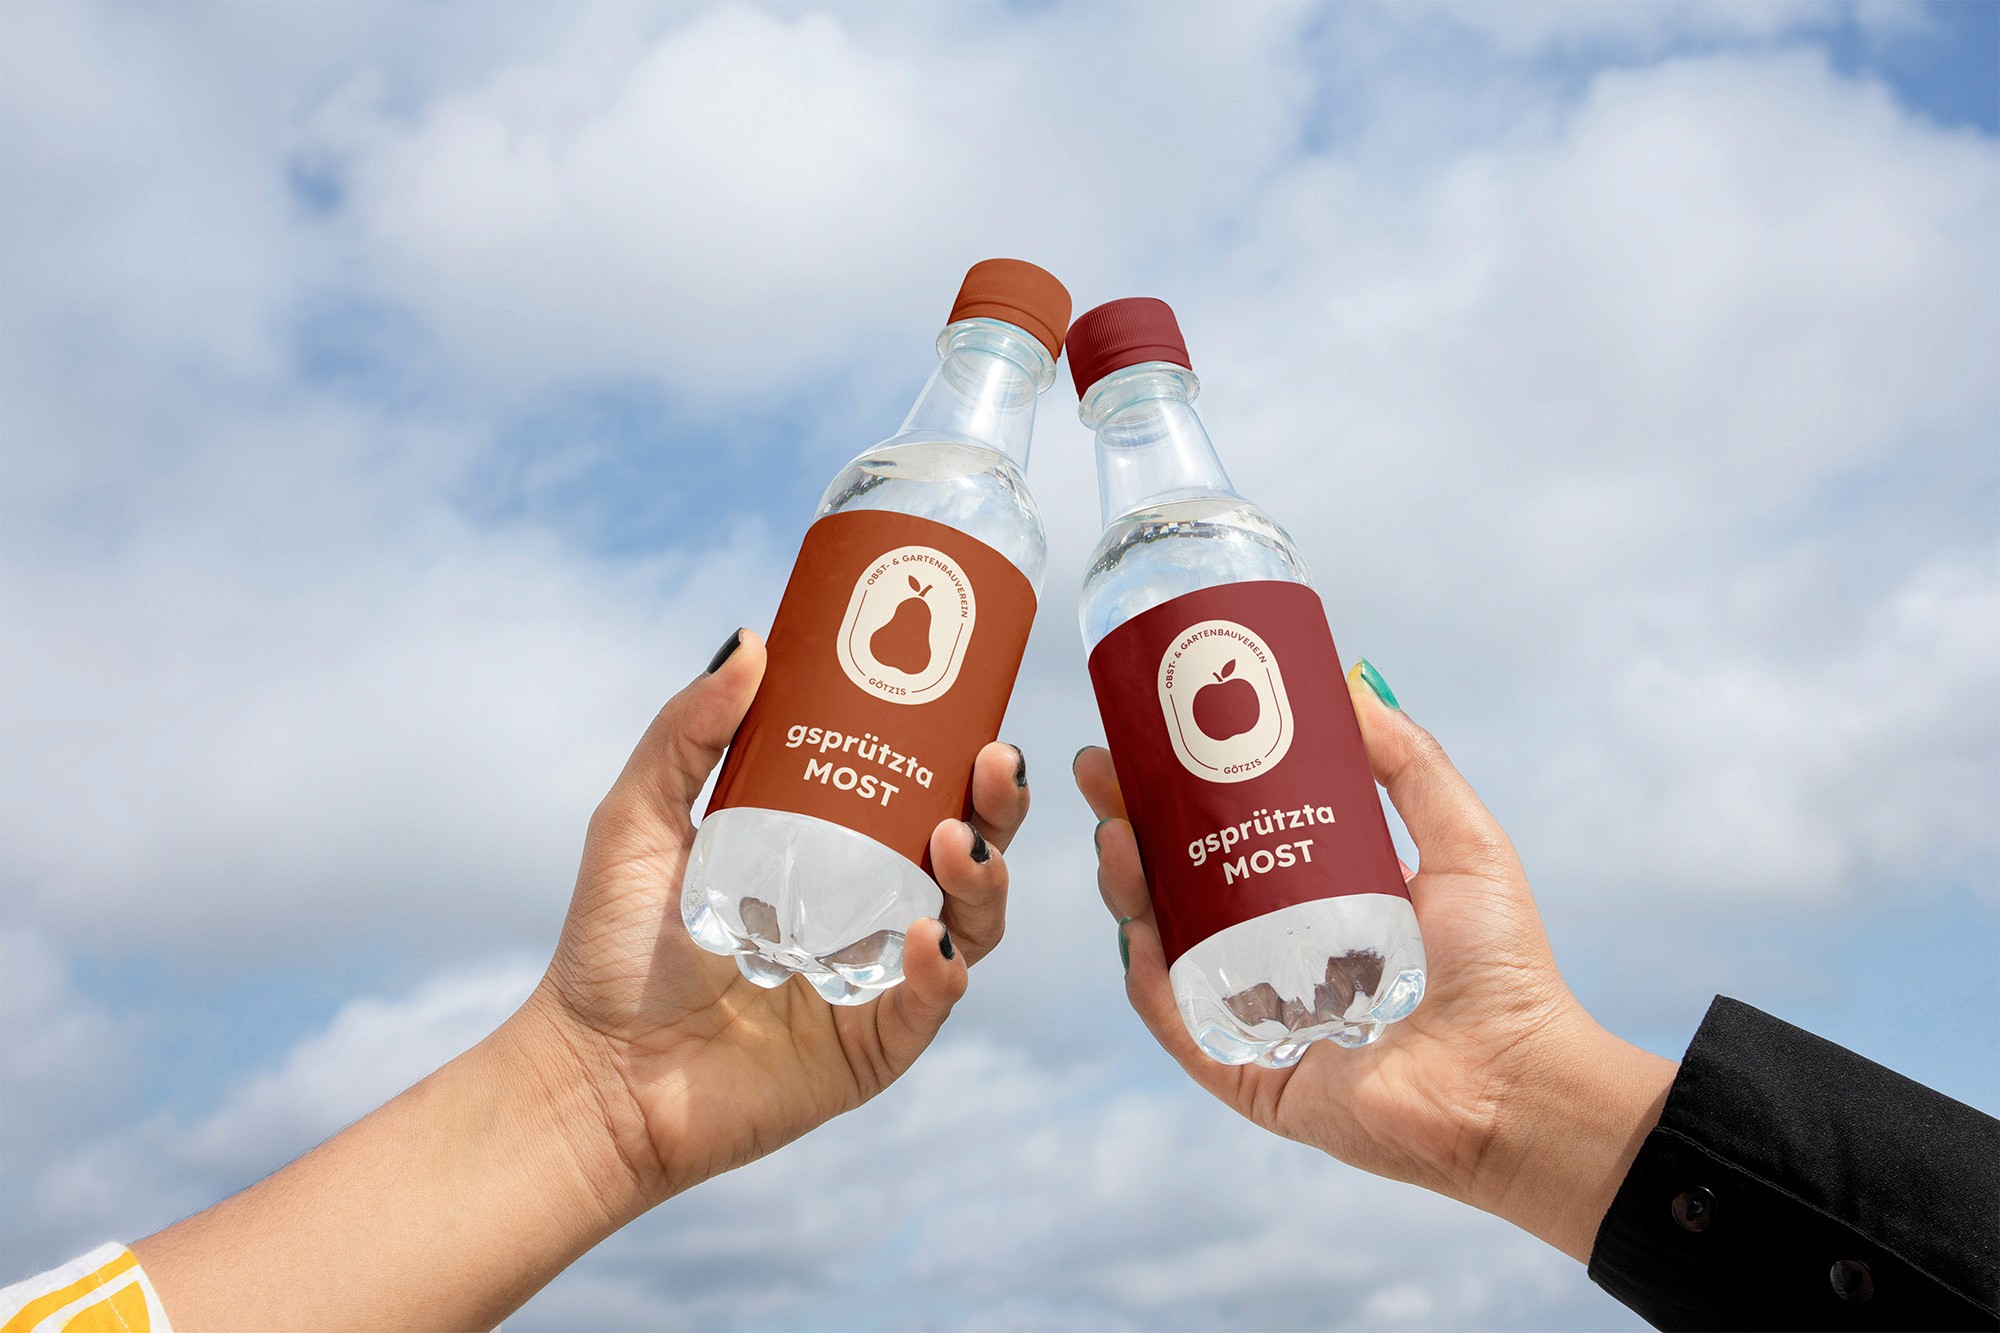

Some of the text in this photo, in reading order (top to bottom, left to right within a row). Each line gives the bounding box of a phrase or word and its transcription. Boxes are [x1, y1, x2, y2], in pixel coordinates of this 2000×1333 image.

[867, 554, 969, 619] OBST- & GARTENBAUVEREIN
[1165, 628, 1267, 689] OBST- & GARTENBAUVEREIN
[868, 677, 907, 696] GÖTZIS
[785, 724, 934, 789] gsprützta
[803, 758, 900, 807] MOST
[1223, 758, 1262, 775] GÖTZIS
[1188, 804, 1336, 867] gsprützta
[1222, 839, 1314, 885] MOST
